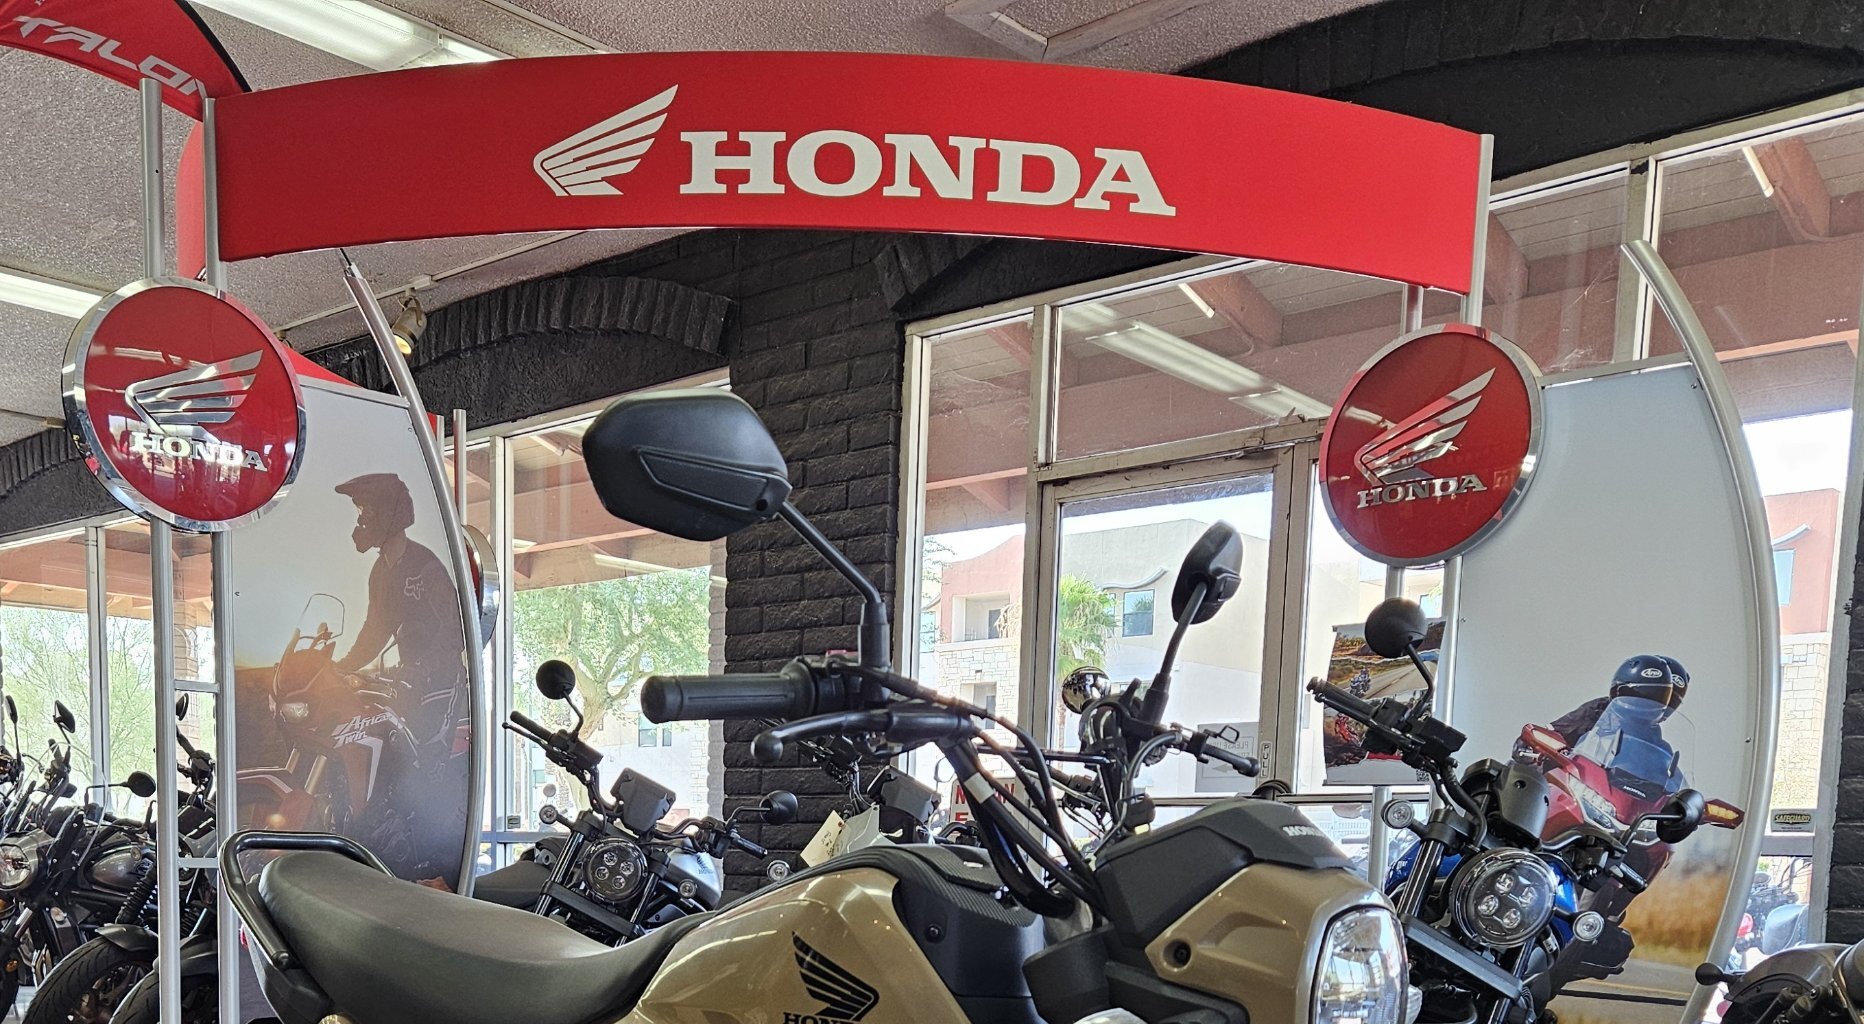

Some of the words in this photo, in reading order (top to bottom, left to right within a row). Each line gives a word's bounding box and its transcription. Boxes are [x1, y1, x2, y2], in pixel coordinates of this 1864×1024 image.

[680, 130, 1176, 217] HONDA
[128, 431, 268, 472] HONDA
[1356, 474, 1487, 509] HONDA
[334, 730, 368, 749] Twin
[339, 712, 390, 736] Africa
[1262, 744, 1270, 777] PULL
